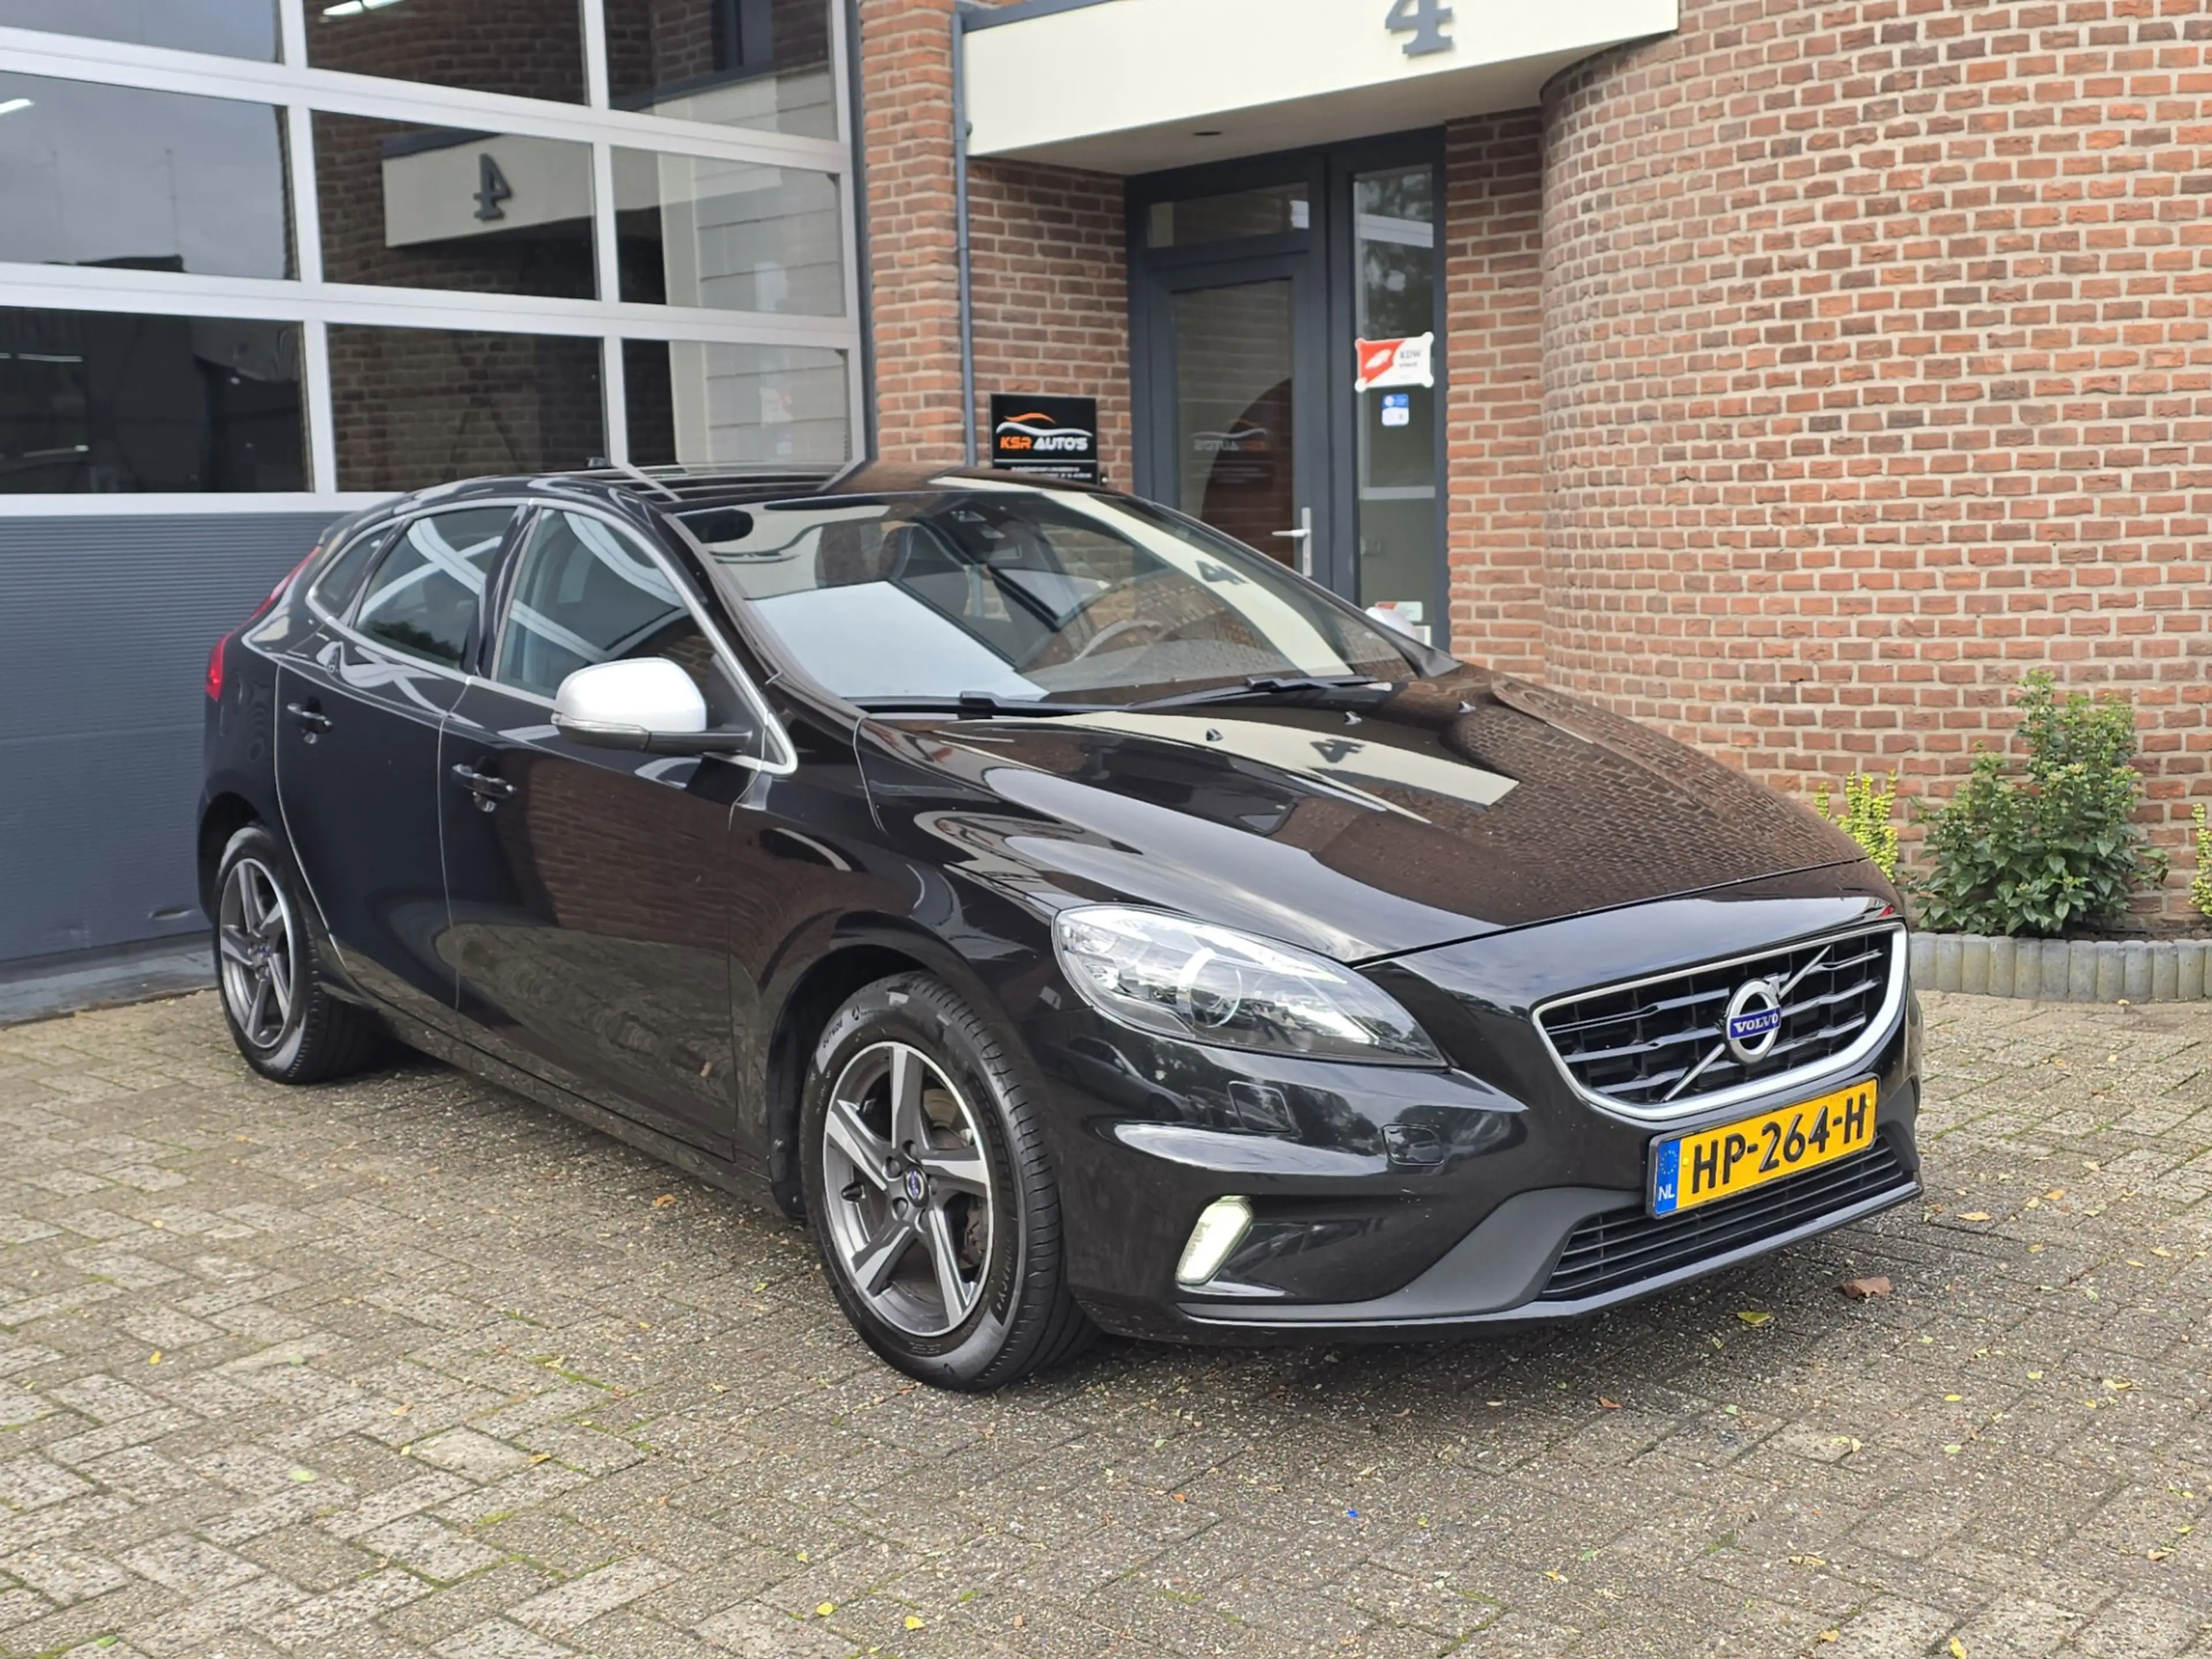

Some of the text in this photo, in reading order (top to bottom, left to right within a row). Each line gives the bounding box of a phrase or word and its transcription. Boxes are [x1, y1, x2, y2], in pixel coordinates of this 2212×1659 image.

[1385, 0, 1453, 56] 4
[999, 437, 1032, 450] KSR
[1733, 1012, 1779, 1033] VOLVO
[1691, 1092, 1866, 1194] HP-264-H
[1658, 1185, 1675, 1202] NL
